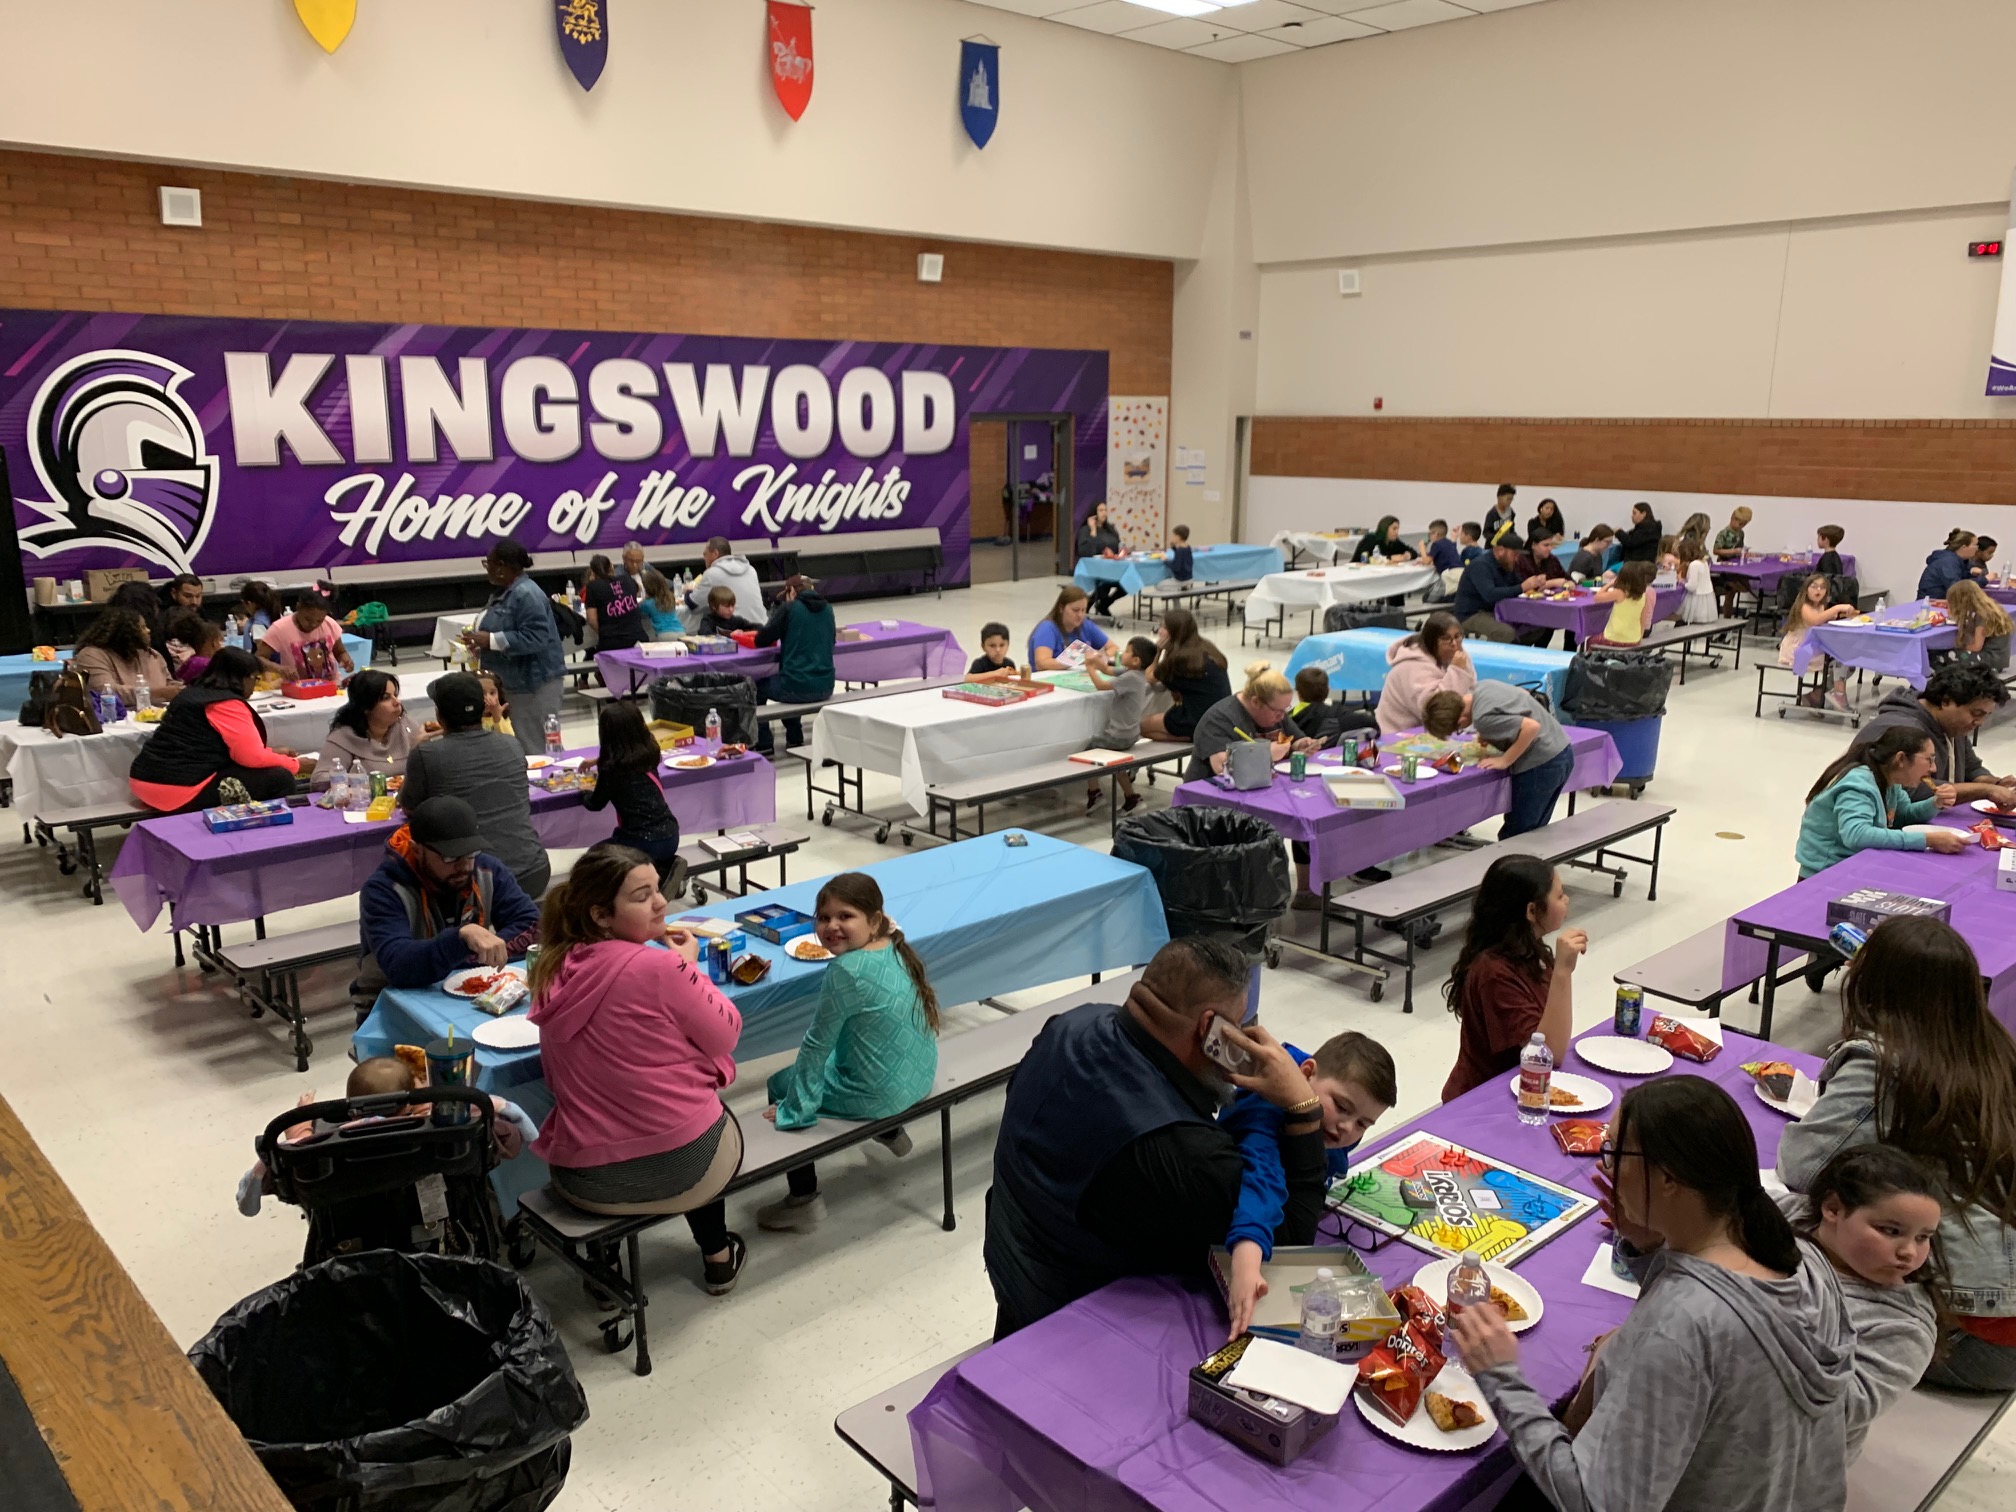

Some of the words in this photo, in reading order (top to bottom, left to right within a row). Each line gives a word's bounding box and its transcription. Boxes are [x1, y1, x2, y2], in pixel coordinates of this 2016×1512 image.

[224, 352, 956, 467] KINGSWOOD
[324, 472, 533, 556] Home
[547, 470, 619, 544] of
[624, 469, 715, 531] the
[731, 463, 912, 532] Knights
[1875, 901, 1930, 916] SLATE
[1423, 1170, 1477, 1228] SORRY!
[1387, 1334, 1429, 1368] Doritos
